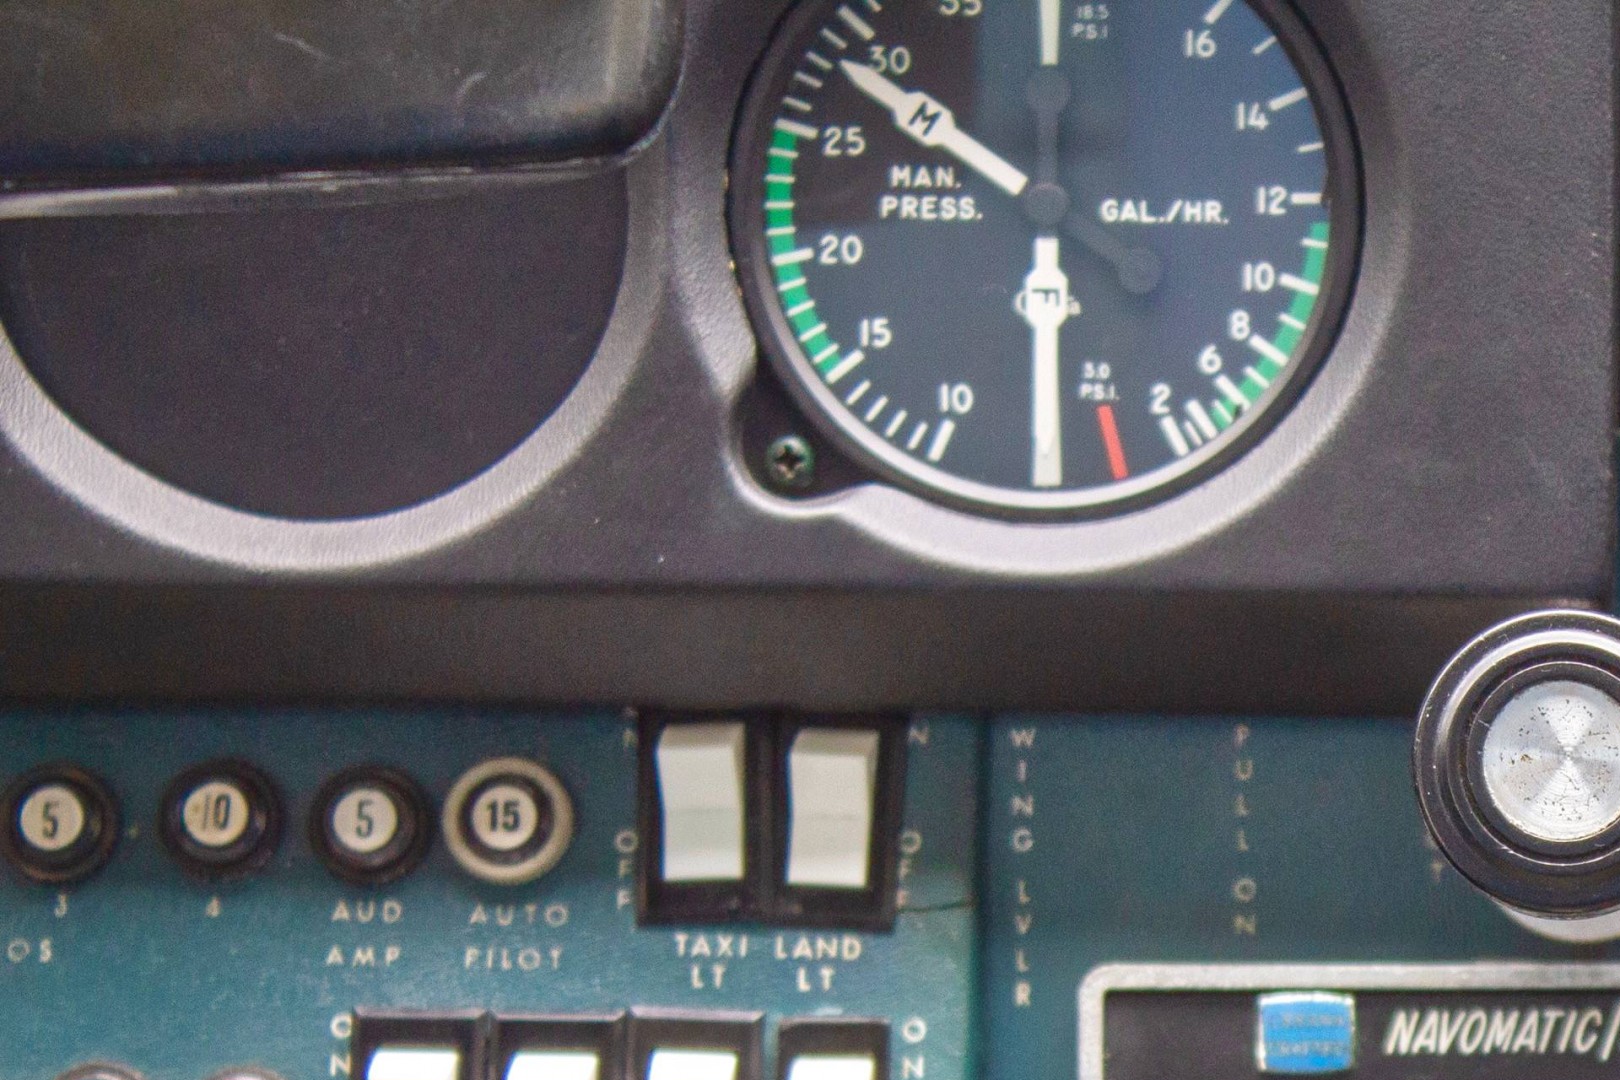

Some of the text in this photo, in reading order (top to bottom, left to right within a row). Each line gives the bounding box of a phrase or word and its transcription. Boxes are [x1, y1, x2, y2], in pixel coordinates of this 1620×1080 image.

[1185, 31, 1217, 57] 16
[870, 46, 911, 74] 30
[907, 102, 941, 131] M
[1235, 103, 1268, 130] 14
[823, 127, 866, 156] 25
[889, 165, 962, 190] MAN.
[880, 196, 984, 221] PRESS.
[1100, 198, 1230, 226] GAL./HR.
[1255, 186, 1287, 214] 12
[819, 236, 864, 263] 20
[1243, 264, 1274, 290] 10
[859, 319, 892, 347] 15
[1230, 311, 1251, 337] 8
[1200, 345, 1221, 372] 6
[939, 384, 973, 412] 10
[1150, 385, 1171, 412] 2
[1010, 728, 1036, 853] WING
[42, 802, 60, 838] 5
[201, 794, 232, 832] 10
[356, 799, 374, 838] 5
[485, 799, 522, 832] 15
[1233, 724, 1256, 936] PULL ON
[332, 901, 402, 924] AUD
[470, 905, 569, 927] AUTO
[326, 946, 400, 967] AMP
[464, 947, 563, 970] PILOT
[676, 934, 748, 958] TAXI
[775, 935, 863, 961] LAND
[692, 965, 727, 990] LT
[797, 967, 836, 993] LT
[901, 1018, 925, 1079] ON
